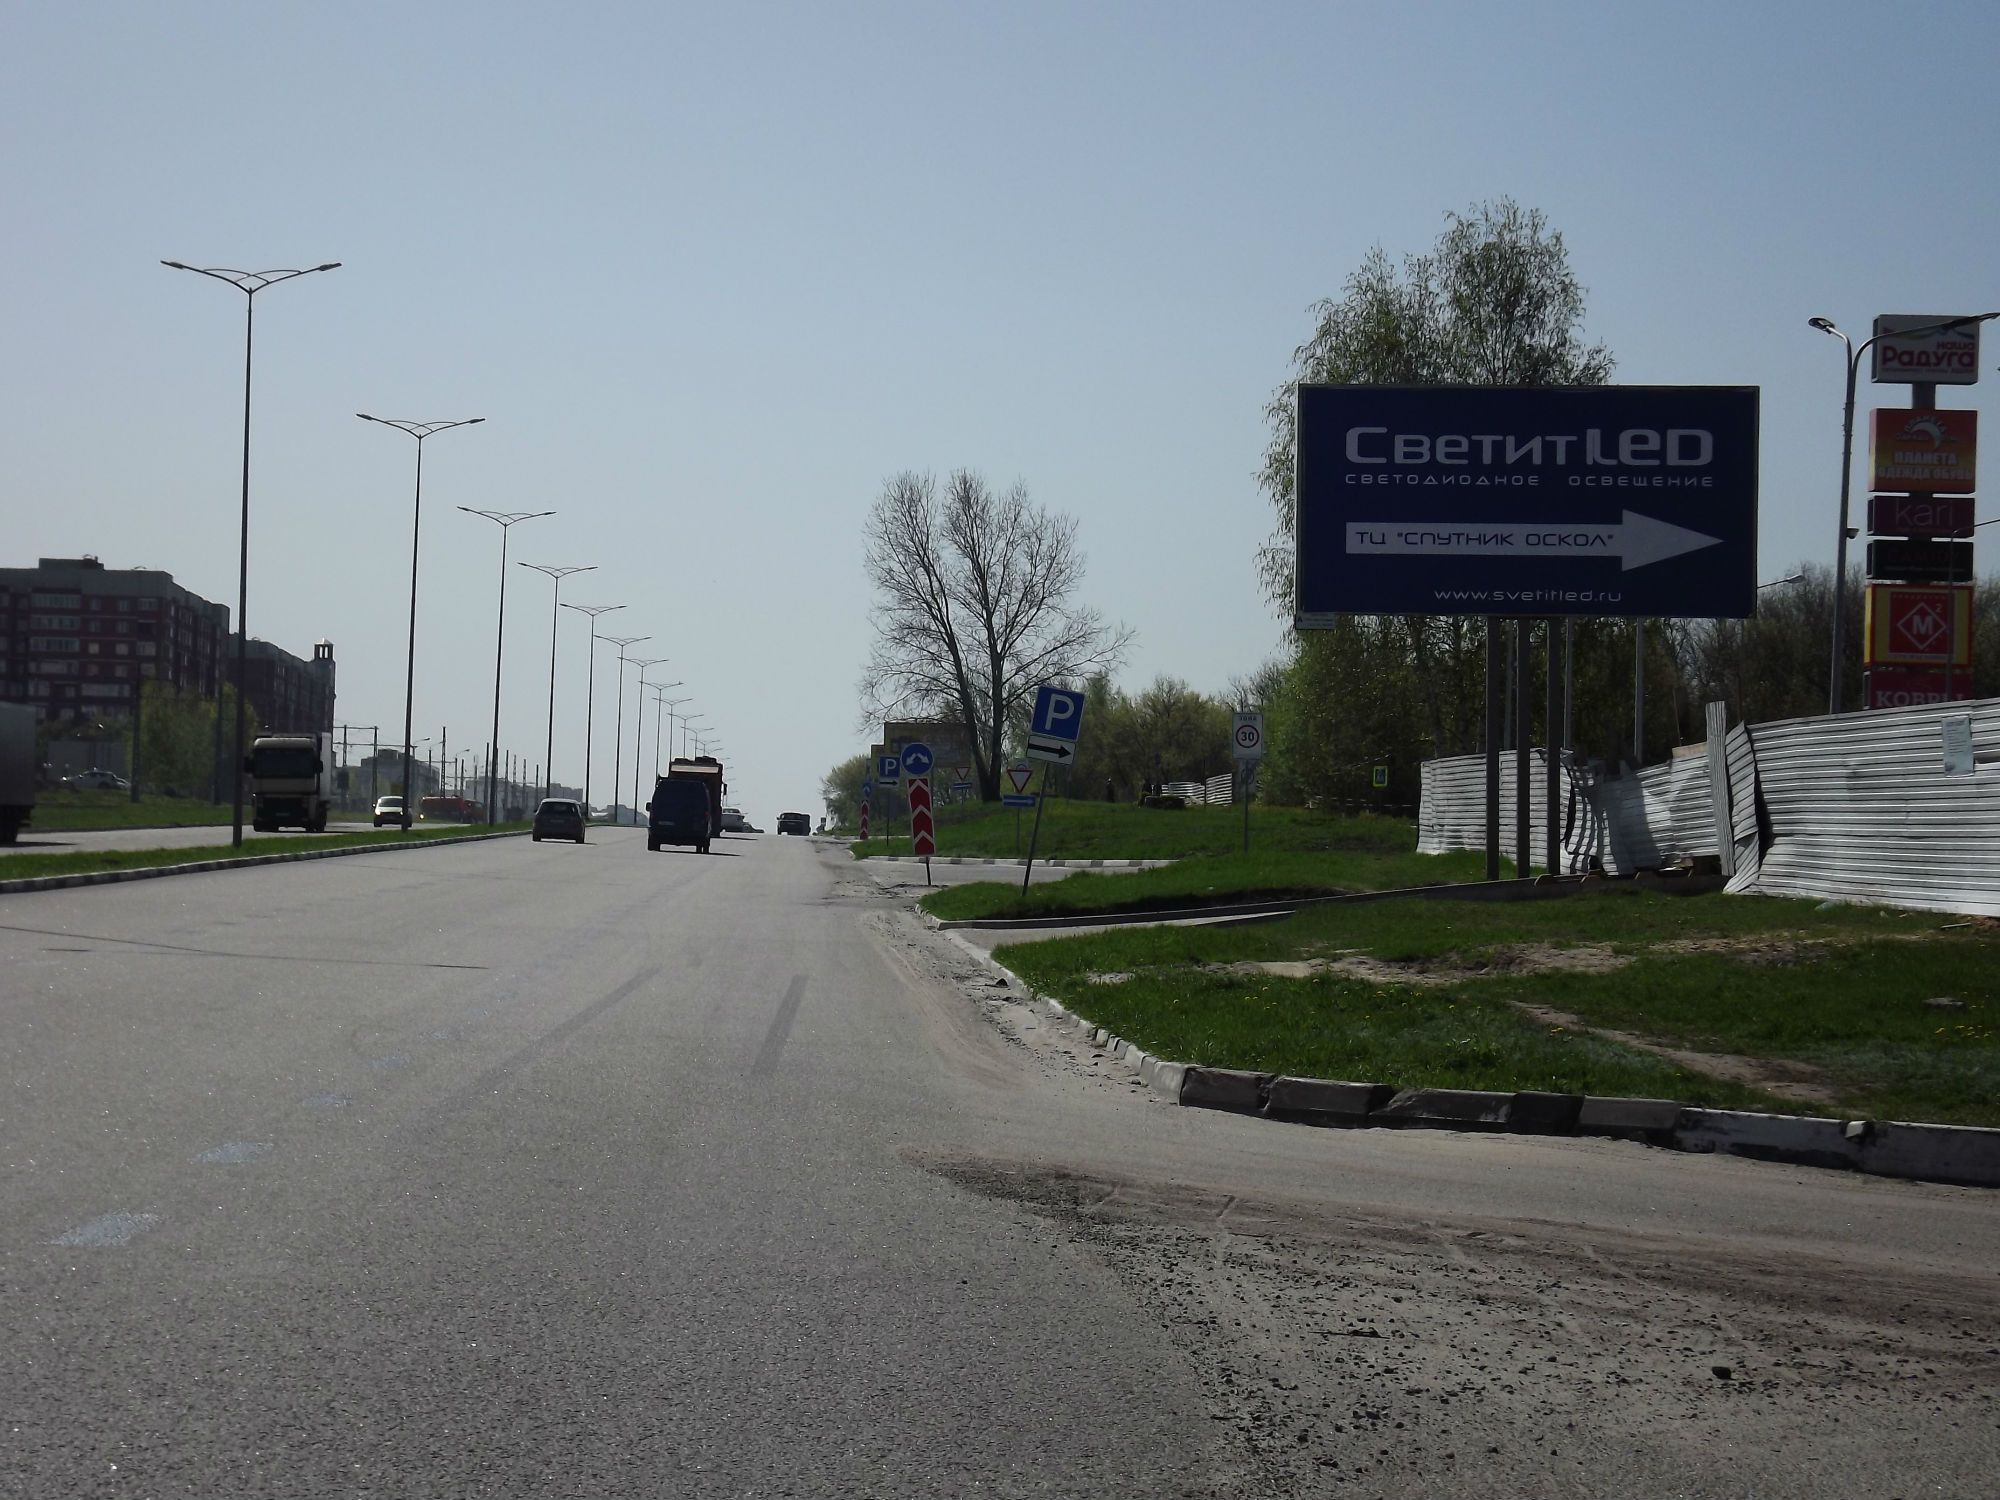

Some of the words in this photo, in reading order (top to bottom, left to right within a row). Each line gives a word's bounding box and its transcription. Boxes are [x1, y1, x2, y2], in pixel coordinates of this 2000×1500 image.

[1881, 345, 1975, 367] Радуга
[1345, 474, 1540, 486] СВЕТОДИОДНОЕ
[1568, 476, 1713, 487] ОСВЕЩЕНИЕ
[1895, 498, 1953, 526] kari
[1356, 532, 1386, 545] ТЦ
[1397, 532, 1514, 546] "СПУТНИК
[1525, 533, 1614, 546] ОСКОЛ"
[1434, 589, 1621, 602] www.svetitled.ru
[1045, 694, 1075, 730] P
[1241, 731, 1254, 741] 30
[884, 758, 897, 775] P
